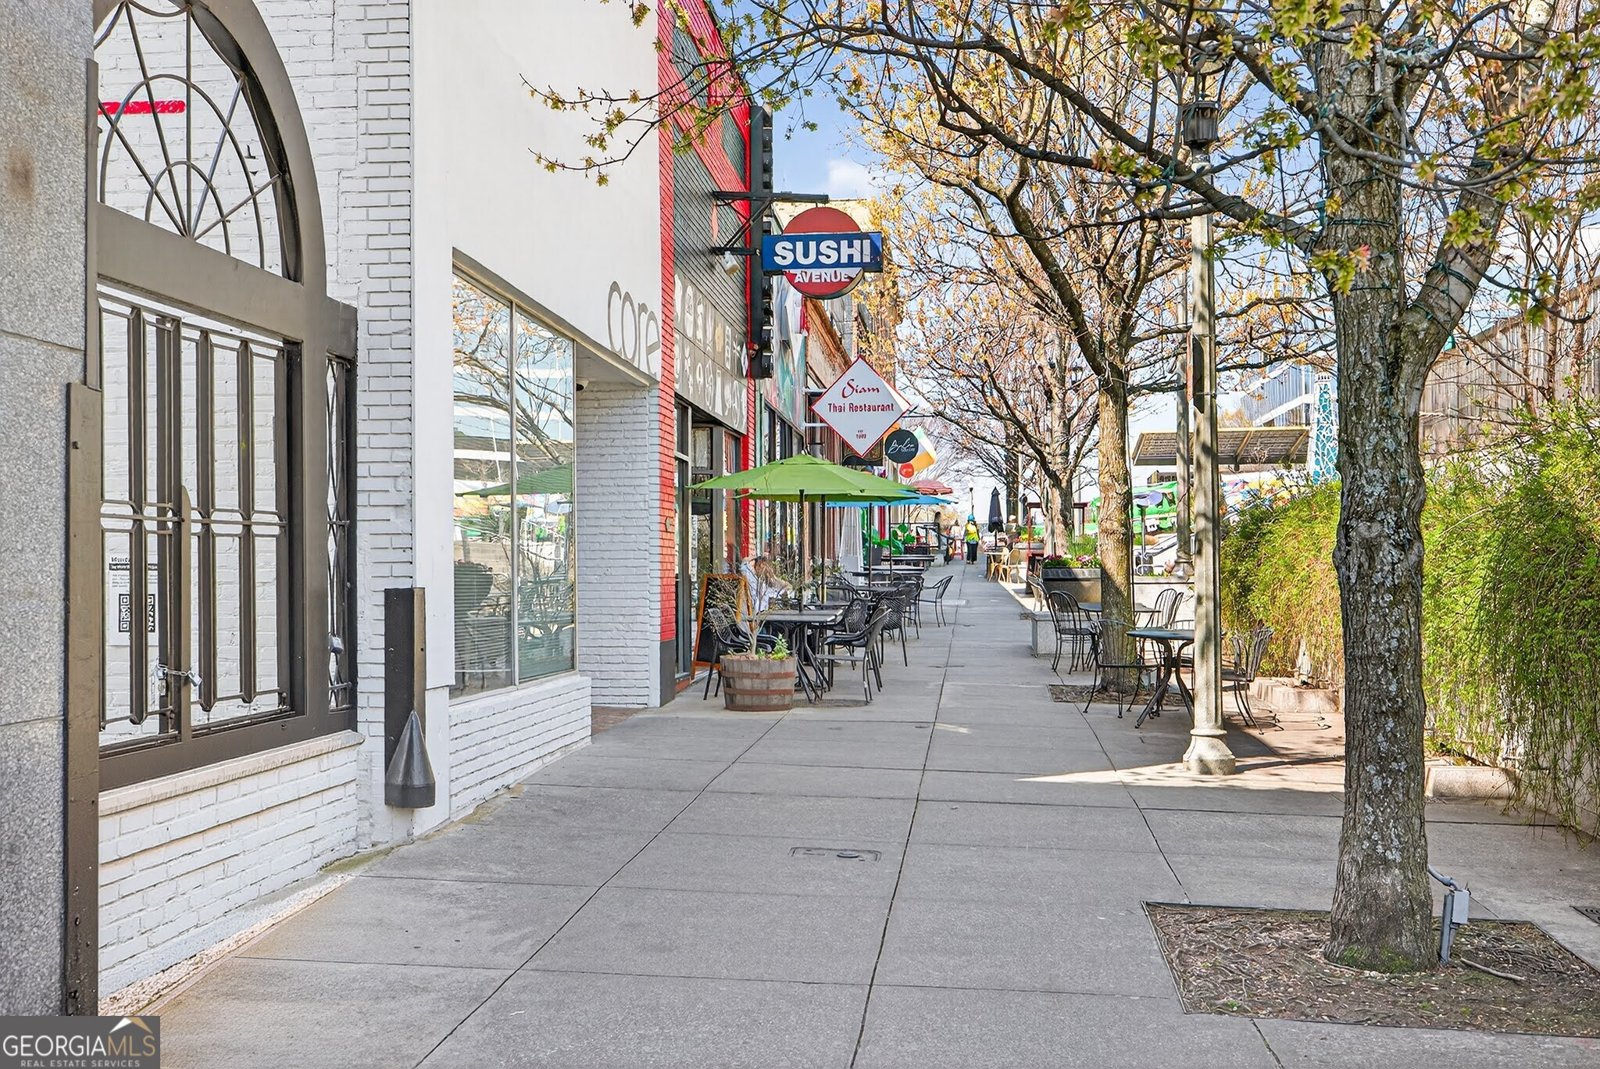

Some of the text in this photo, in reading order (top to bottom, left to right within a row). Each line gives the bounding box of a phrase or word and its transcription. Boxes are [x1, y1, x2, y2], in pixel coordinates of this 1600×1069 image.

[773, 239, 871, 265] SUSHI
[794, 270, 850, 283] AVENUE
[608, 280, 660, 379] core
[842, 378, 880, 399] Siam
[828, 402, 894, 413] Thai Restaurant
